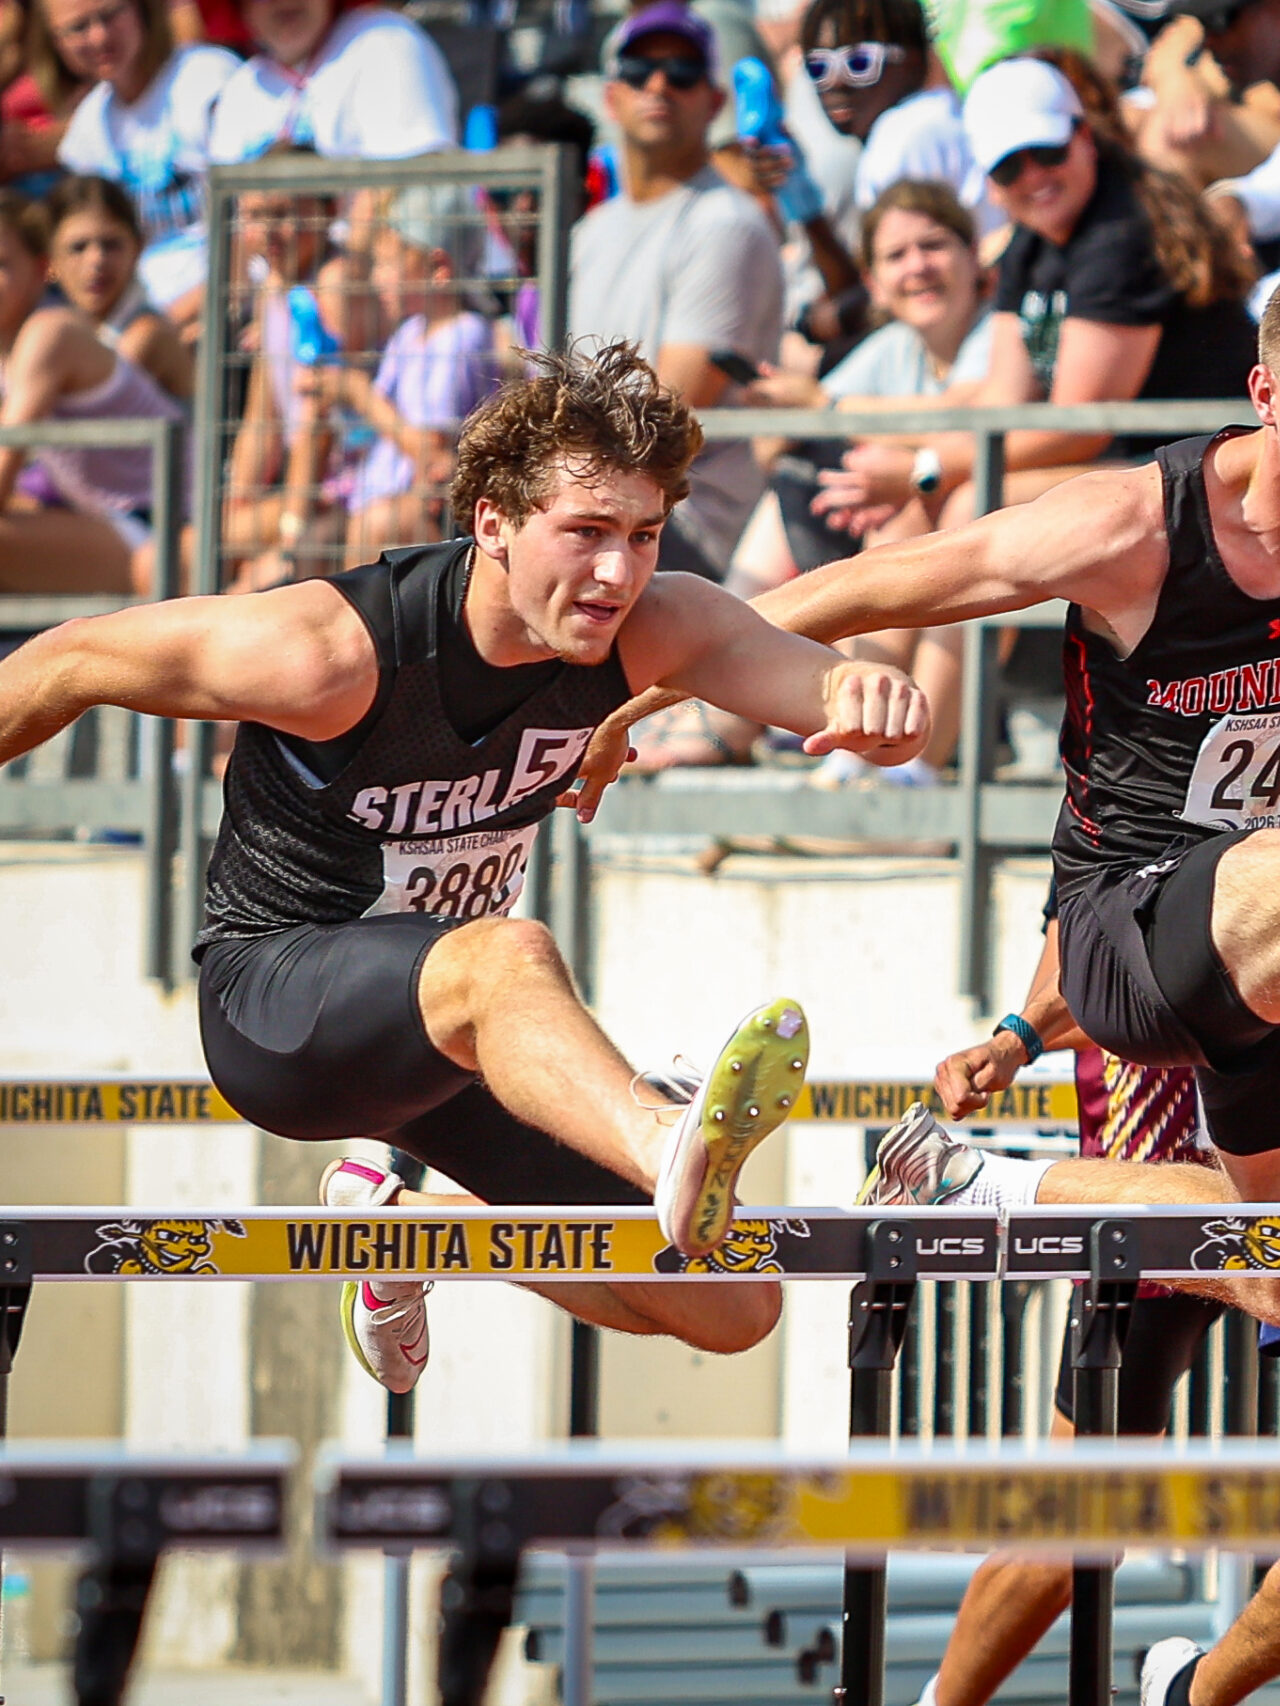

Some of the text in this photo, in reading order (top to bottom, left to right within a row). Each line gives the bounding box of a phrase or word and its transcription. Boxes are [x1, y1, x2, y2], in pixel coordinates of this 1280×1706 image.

[1225, 717, 1267, 732] KSHSAA
[512, 737, 570, 797] 5
[346, 769, 515, 834] STERL
[1244, 817, 1275, 829] 2026
[400, 840, 444, 855] KSHSAA
[447, 835, 478, 853] STATE
[0, 1084, 211, 1121] ICHITA STATE
[286, 1222, 985, 1271] WICHITA STATE UCS
[1014, 1236, 1084, 1254] UCS
